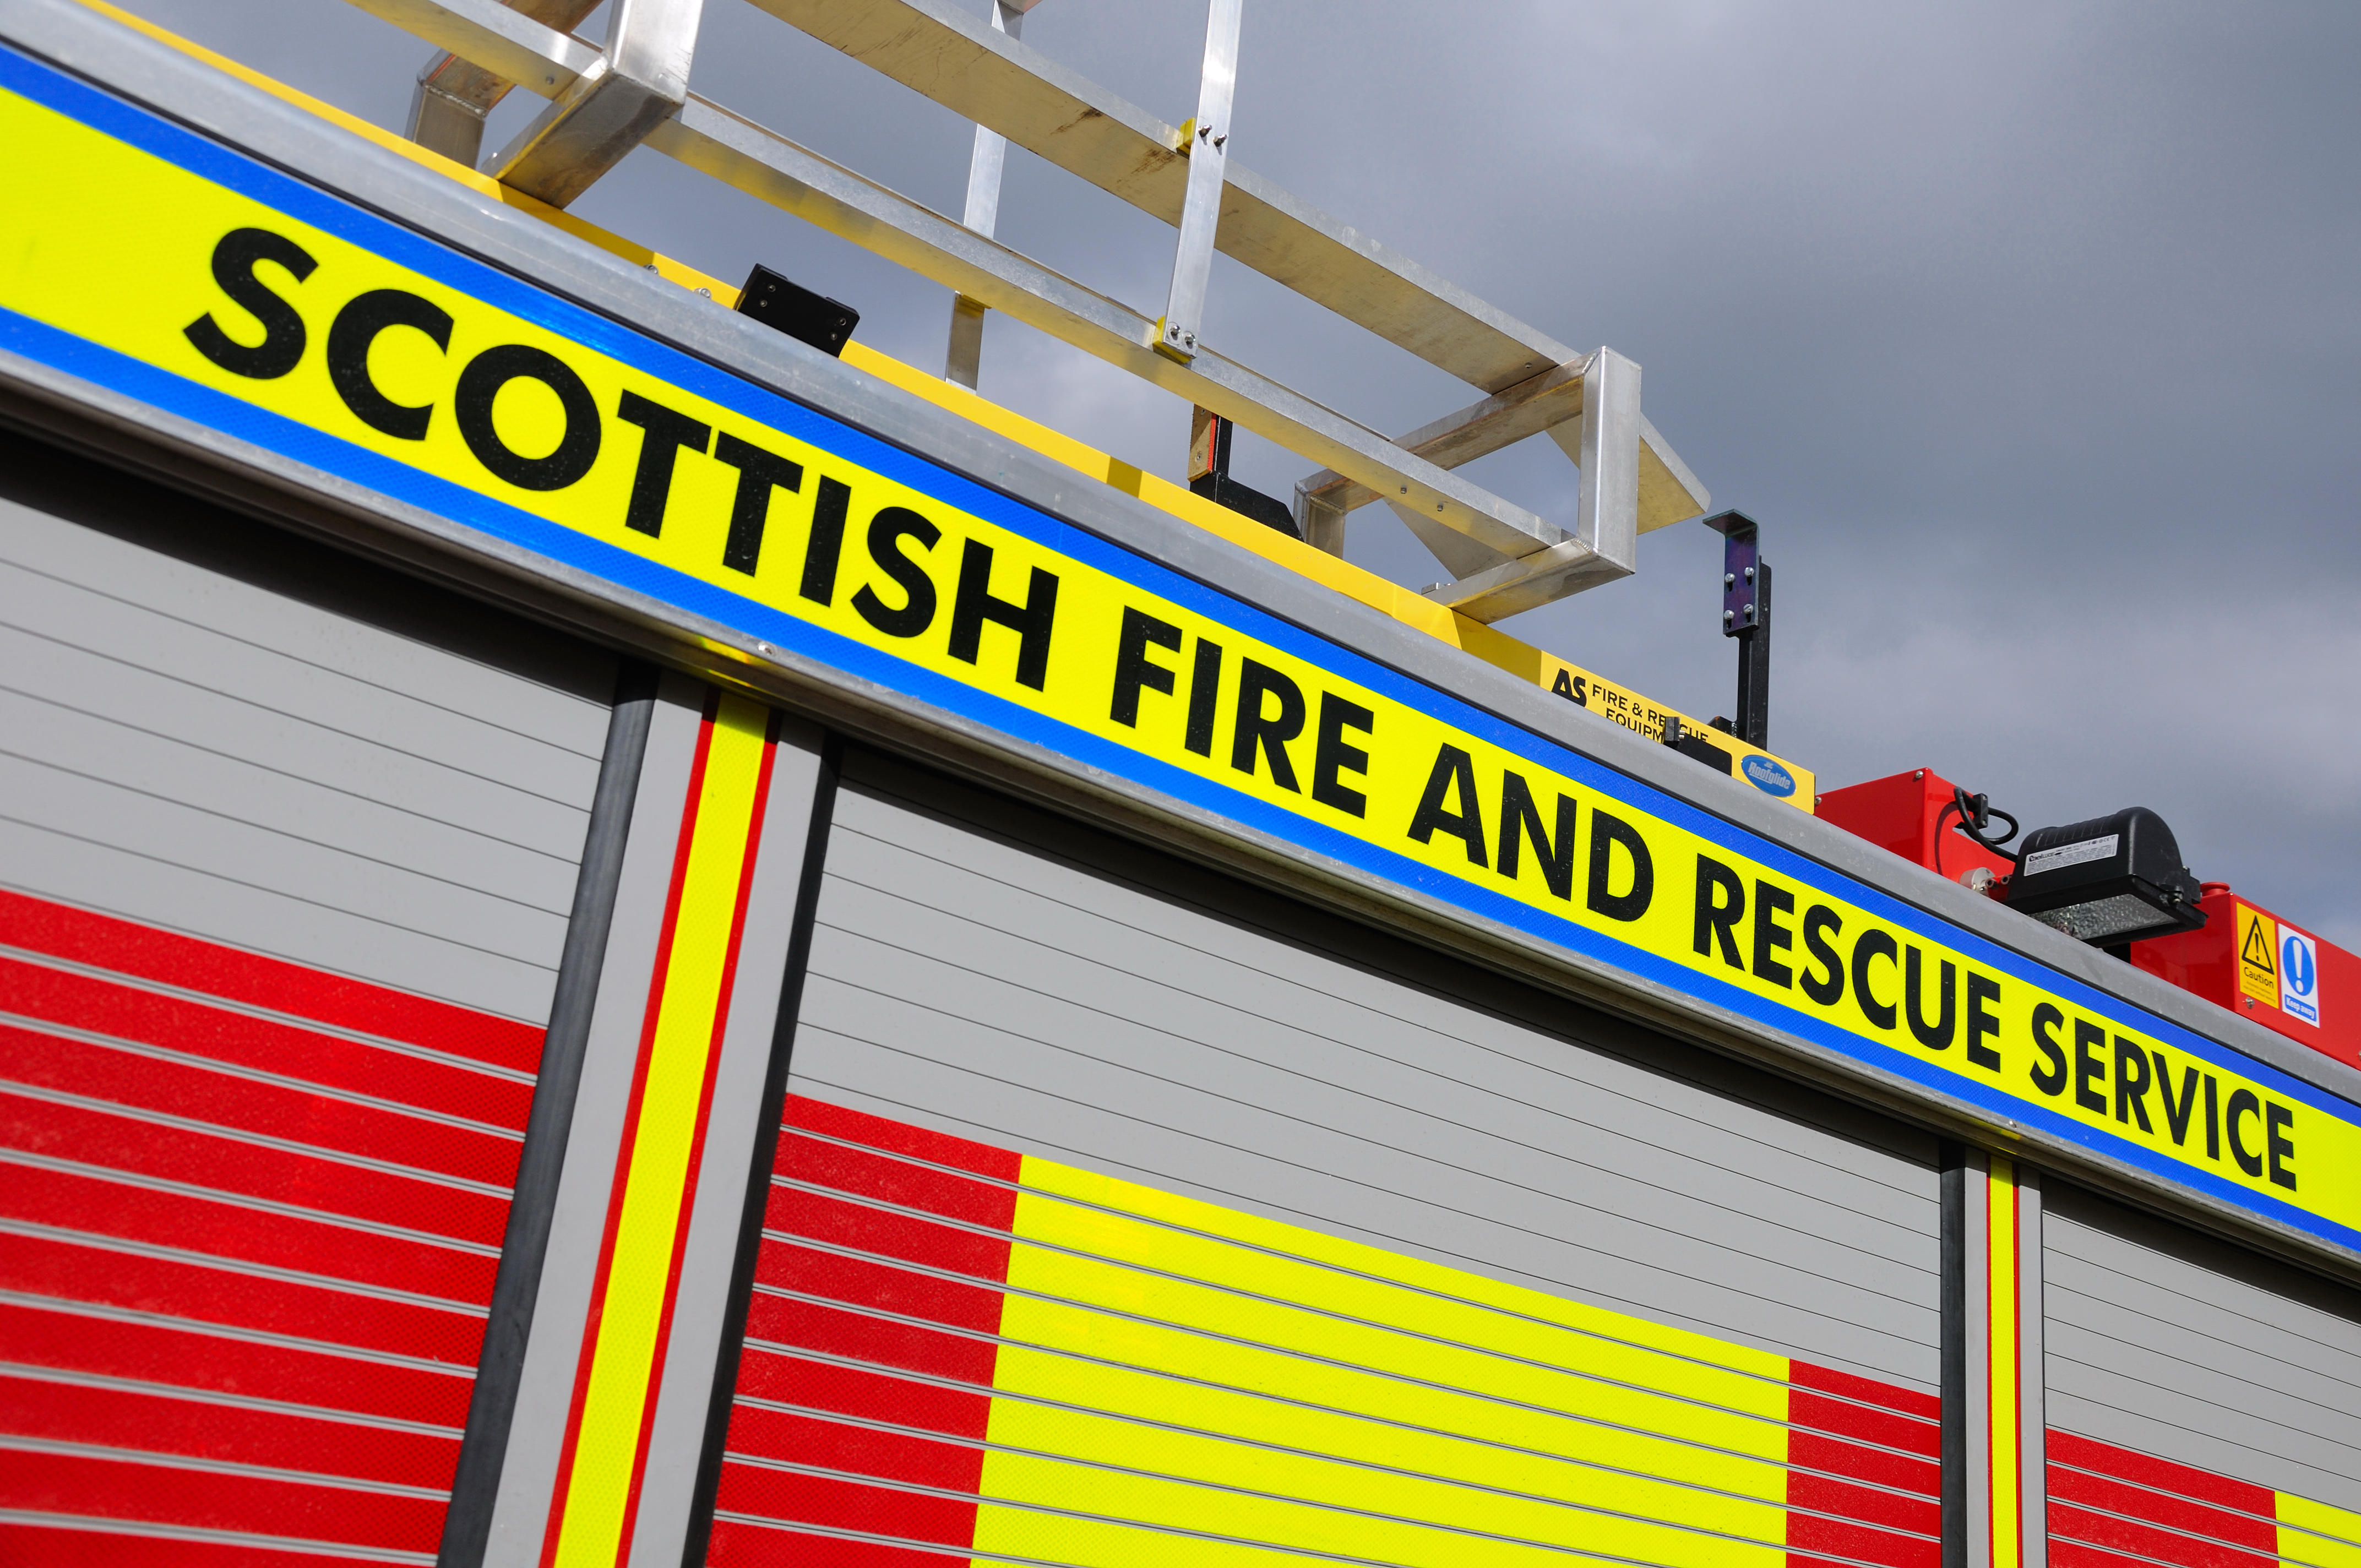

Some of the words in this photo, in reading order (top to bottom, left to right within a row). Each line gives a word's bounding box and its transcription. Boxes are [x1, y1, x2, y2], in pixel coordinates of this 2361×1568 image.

[183, 228, 1059, 692] SCOTTISH
[1110, 606, 1374, 819] FIRE
[1407, 743, 1653, 922] AND
[1693, 853, 2000, 1072] RESCUE
[2030, 1003, 2296, 1191] SERVICE
[1552, 668, 1587, 707] AS
[1592, 683, 1628, 711] FIRE
[1632, 703, 1642, 718] &
[1648, 708, 1709, 742] RECUE
[1606, 707, 1663, 744] EQUIPM
[1748, 761, 1791, 790] Roofglide
[2244, 967, 2274, 989] Caution
